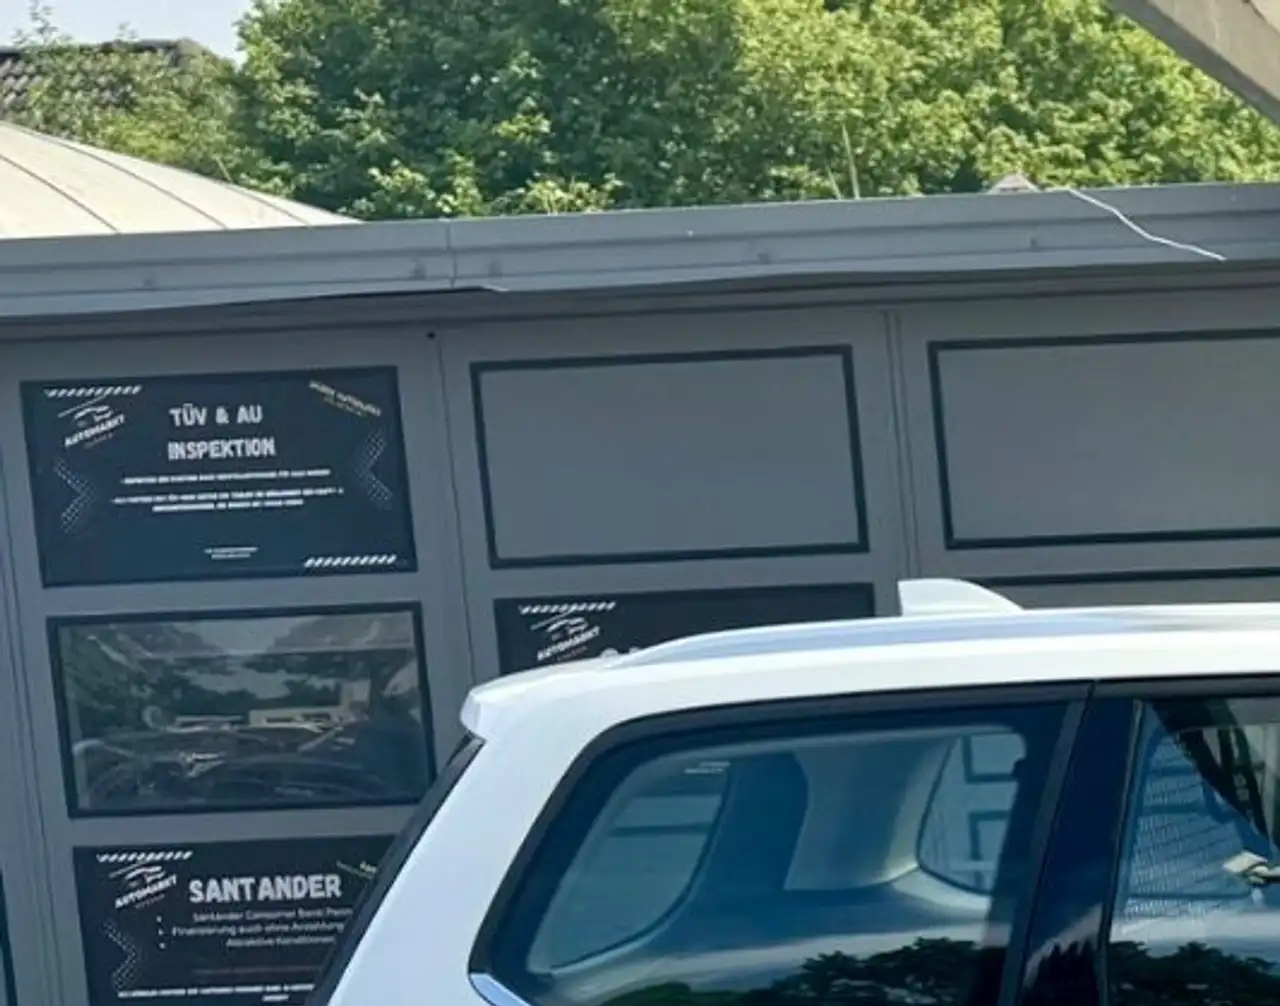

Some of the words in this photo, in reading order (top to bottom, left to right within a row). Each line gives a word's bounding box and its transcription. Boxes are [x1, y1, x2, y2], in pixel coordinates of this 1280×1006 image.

[168, 402, 207, 427] TÜV
[216, 405, 229, 425] &
[237, 403, 263, 424] AU
[167, 436, 276, 462] INSPEKTION
[188, 873, 342, 903] SANTANDER
